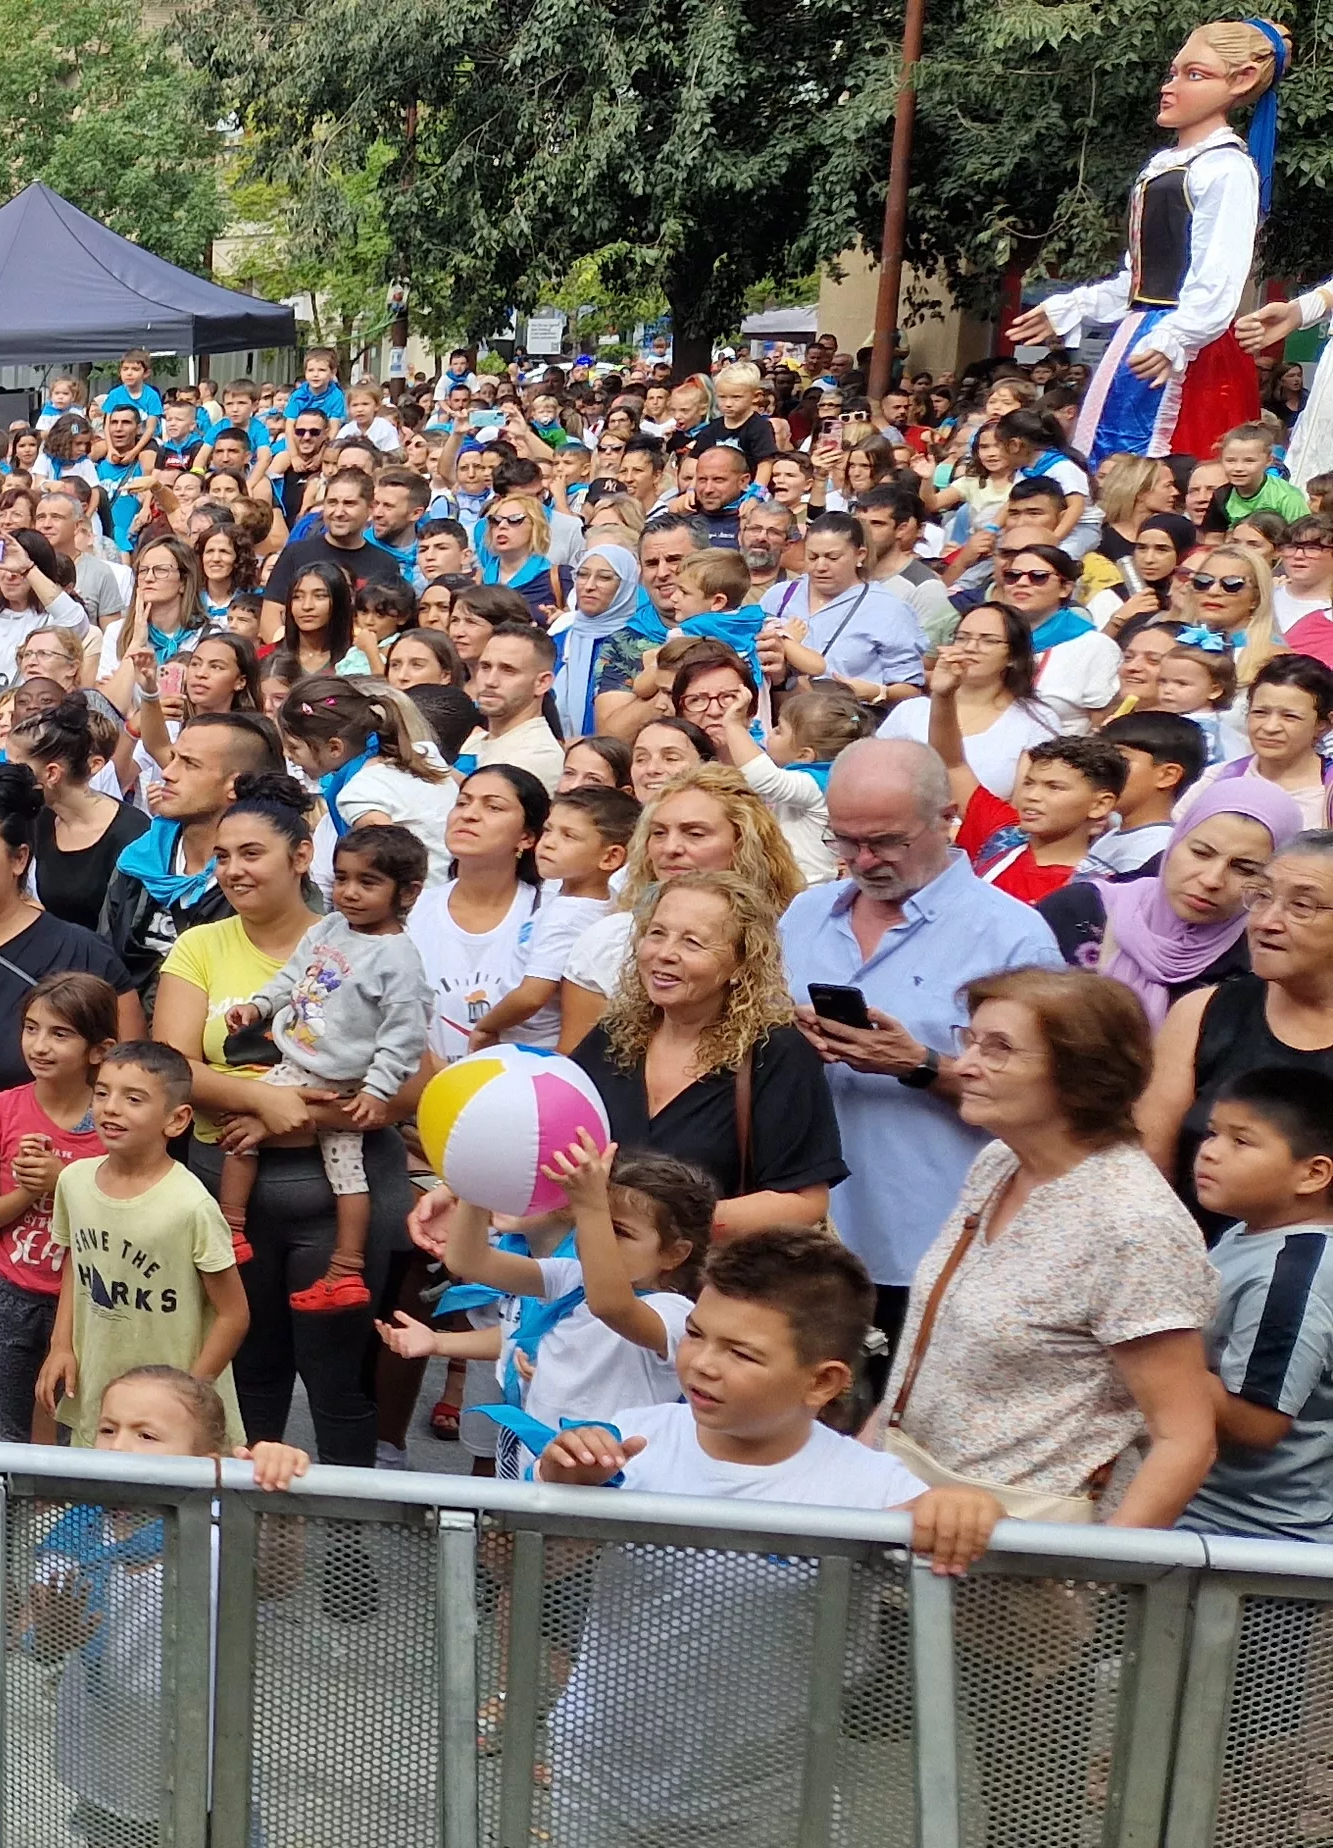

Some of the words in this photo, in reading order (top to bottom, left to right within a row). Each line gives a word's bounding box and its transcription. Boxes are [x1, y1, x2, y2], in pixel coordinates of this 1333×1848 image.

[9, 1226, 66, 1272] SEA
[75, 1228, 109, 1254] SAVE
[121, 1238, 161, 1279] THE
